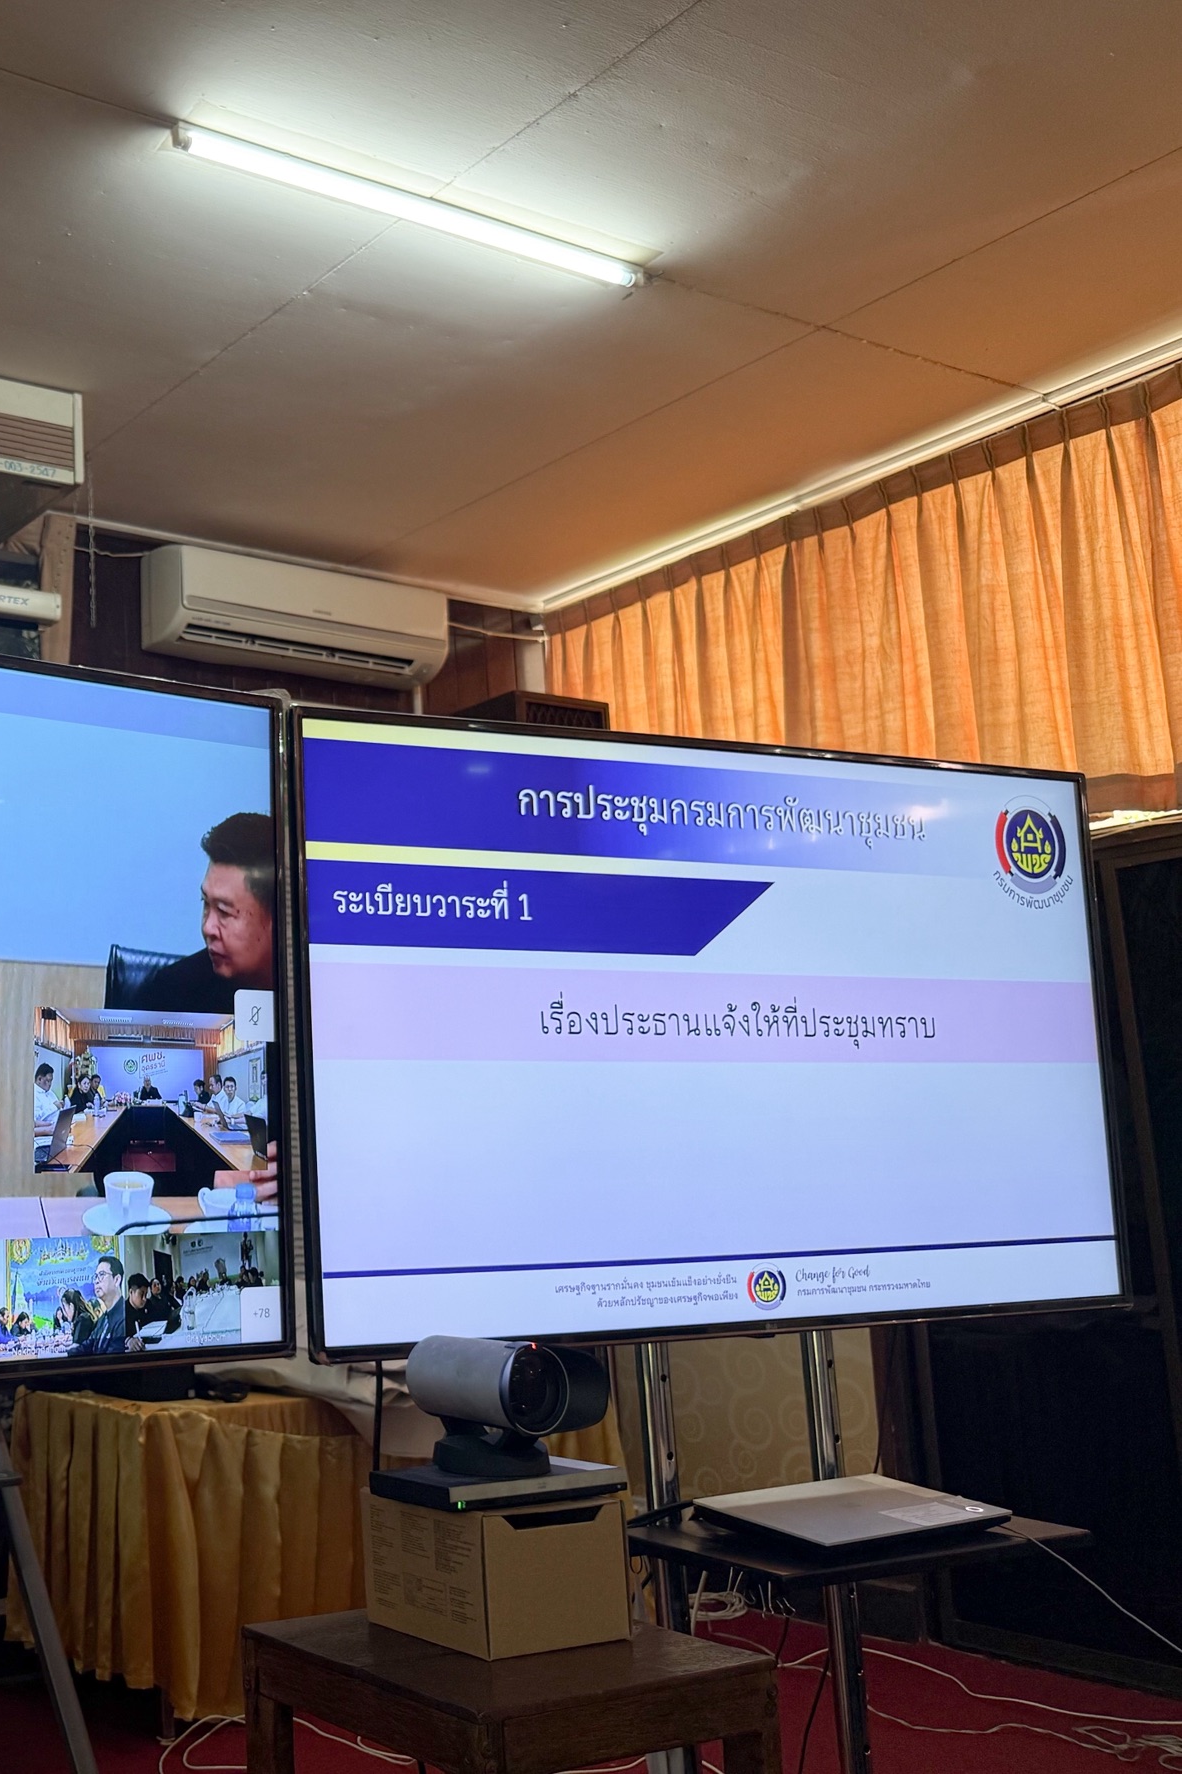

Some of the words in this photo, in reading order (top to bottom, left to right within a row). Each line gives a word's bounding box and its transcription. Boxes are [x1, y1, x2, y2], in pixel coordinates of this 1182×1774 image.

[517, 784, 927, 850] การประชุมกรมการพัฒนาชุมชน
[332, 880, 510, 921] ระเบียบวาระที่
[517, 893, 534, 921] 1
[993, 869, 1075, 910] กรมการพัฒนาชุมชน
[540, 991, 937, 1050] เรื่องประธานแจ้งให้ที่ประชุมทราบ
[795, 1267, 830, 1284] Change
[831, 1267, 846, 1284] for
[848, 1265, 871, 1279] Good
[797, 1284, 867, 1297] กรมการพัฒนาชุมชน
[868, 1278, 931, 1293] กระทรวงมหาดไทย
[253, 1307, 271, 1319] +78
